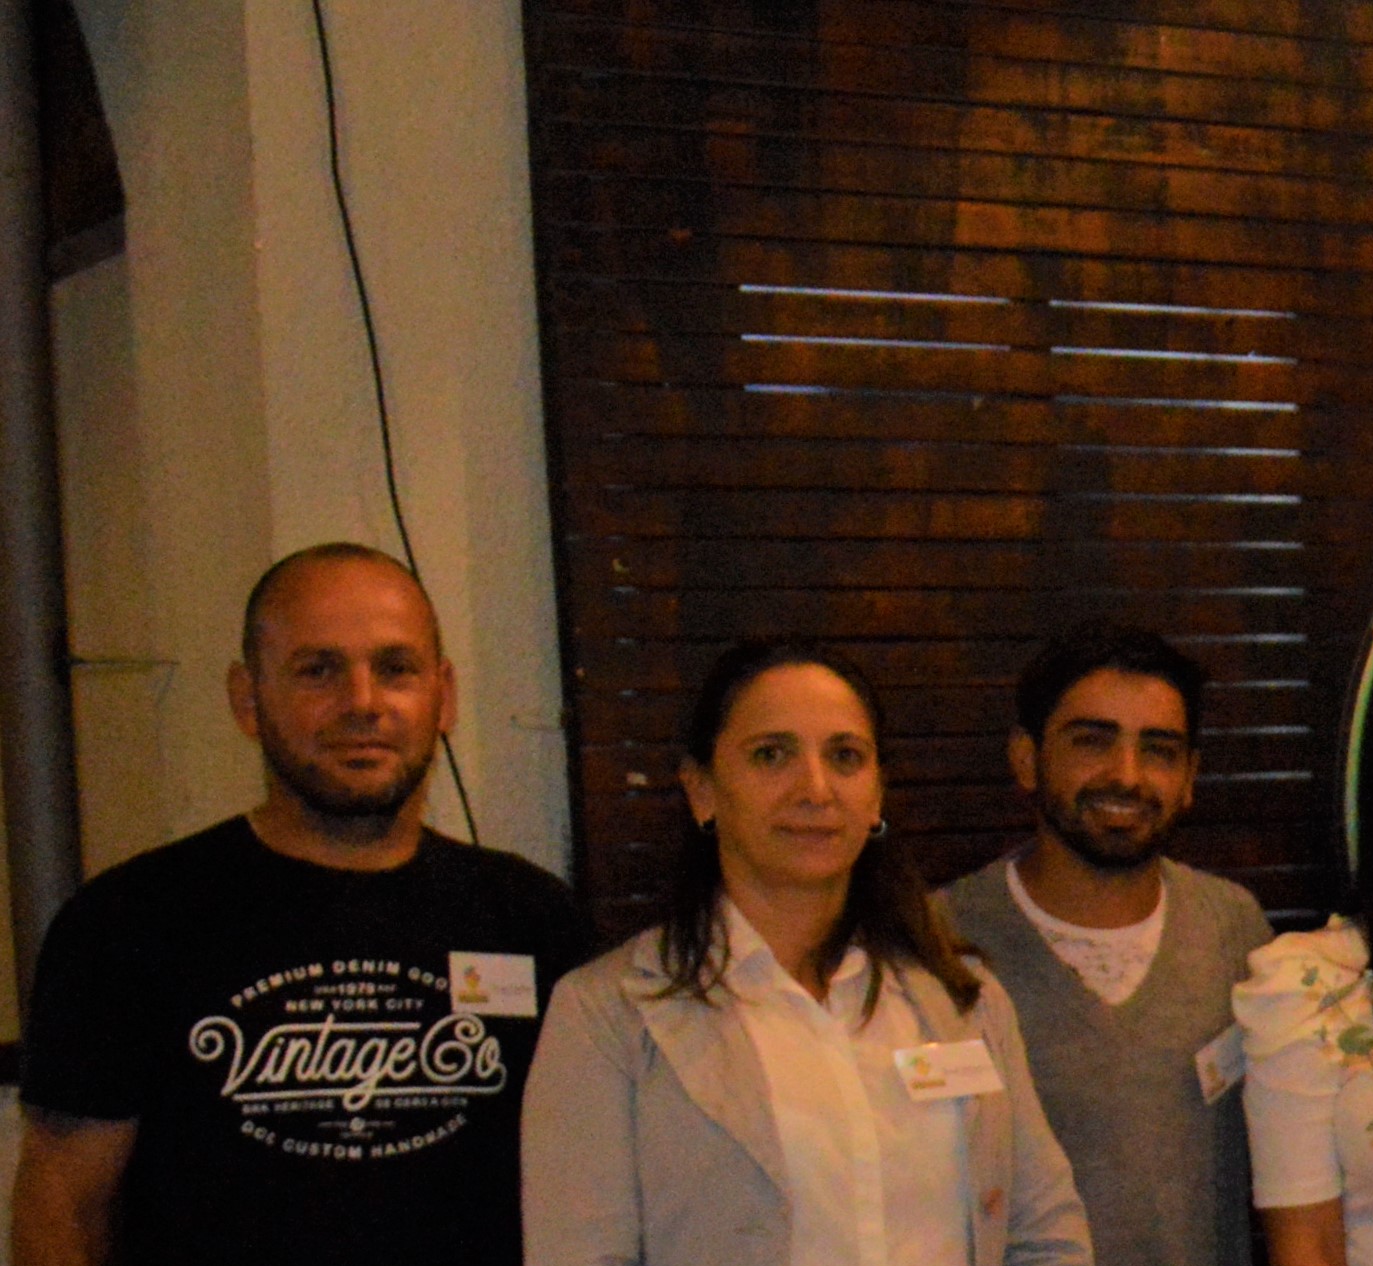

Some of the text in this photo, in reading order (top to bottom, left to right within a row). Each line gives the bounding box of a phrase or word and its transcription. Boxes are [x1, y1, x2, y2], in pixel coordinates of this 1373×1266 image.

[231, 959, 449, 1008] PREMIUM DENIM GOO
[285, 998, 426, 1013] NEW YORK CITY
[189, 1013, 421, 1111] Vintage
[282, 1137, 363, 1160] CUSTOM
[370, 1113, 468, 1158] HANDMADE
